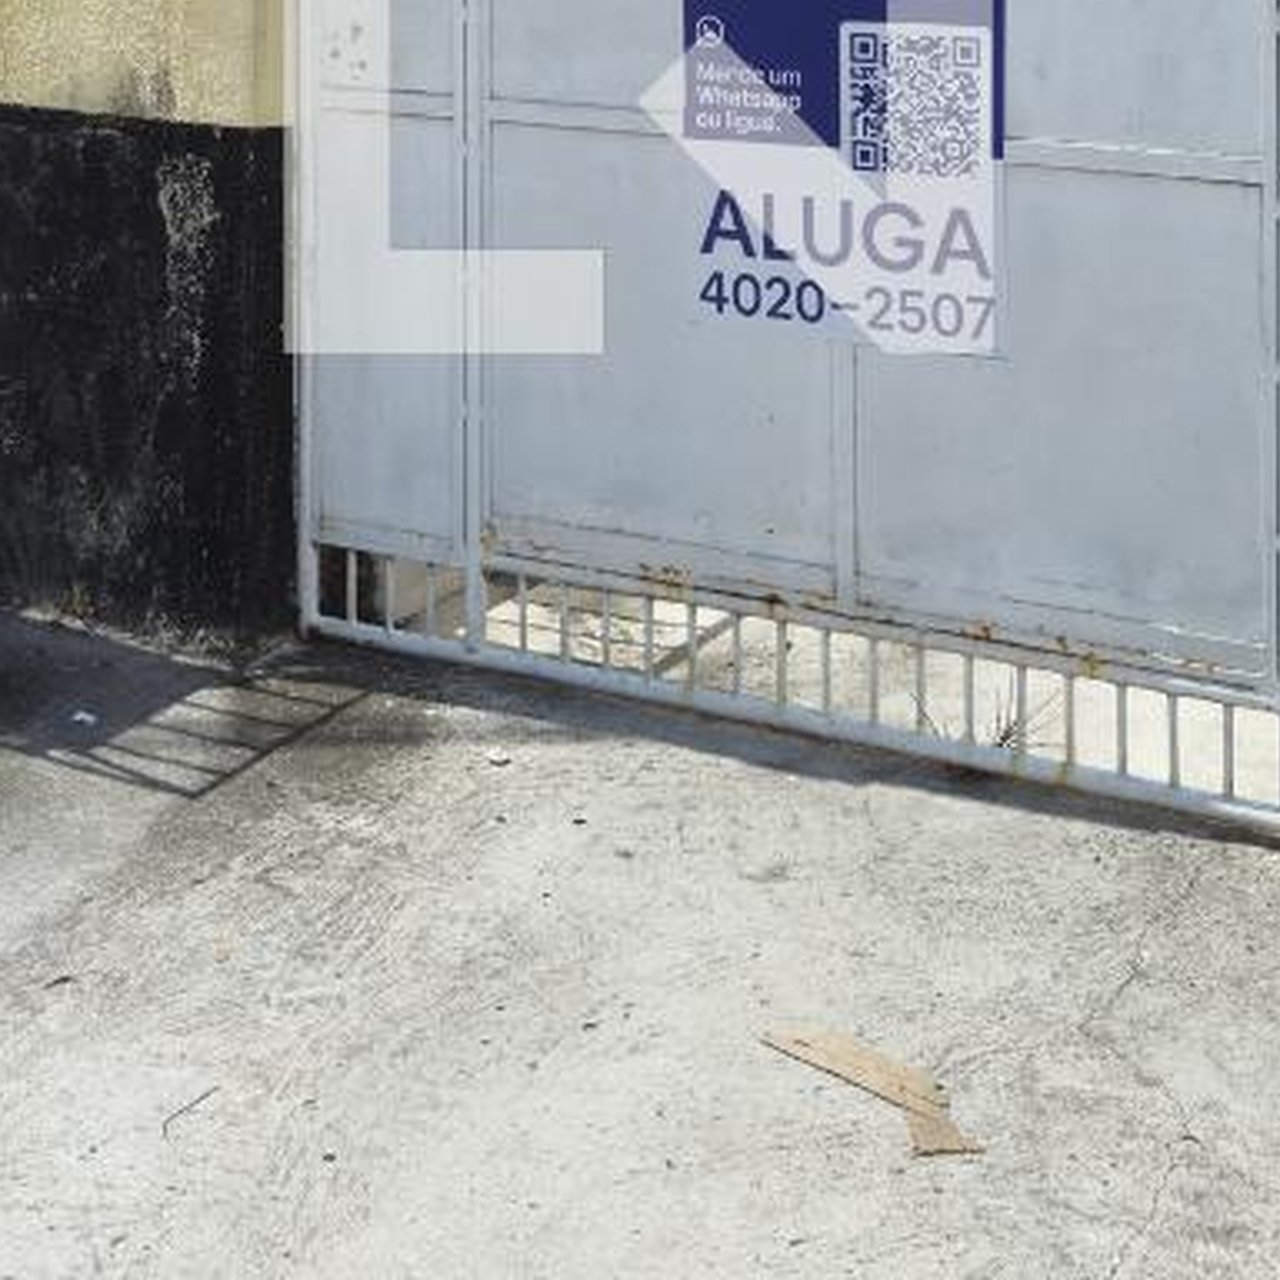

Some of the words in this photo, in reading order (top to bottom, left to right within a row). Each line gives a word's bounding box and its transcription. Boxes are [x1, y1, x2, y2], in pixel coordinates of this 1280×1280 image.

[769, 69, 801, 87] um
[700, 189, 992, 280] ALUGA
[700, 271, 996, 340] 4020-2507
